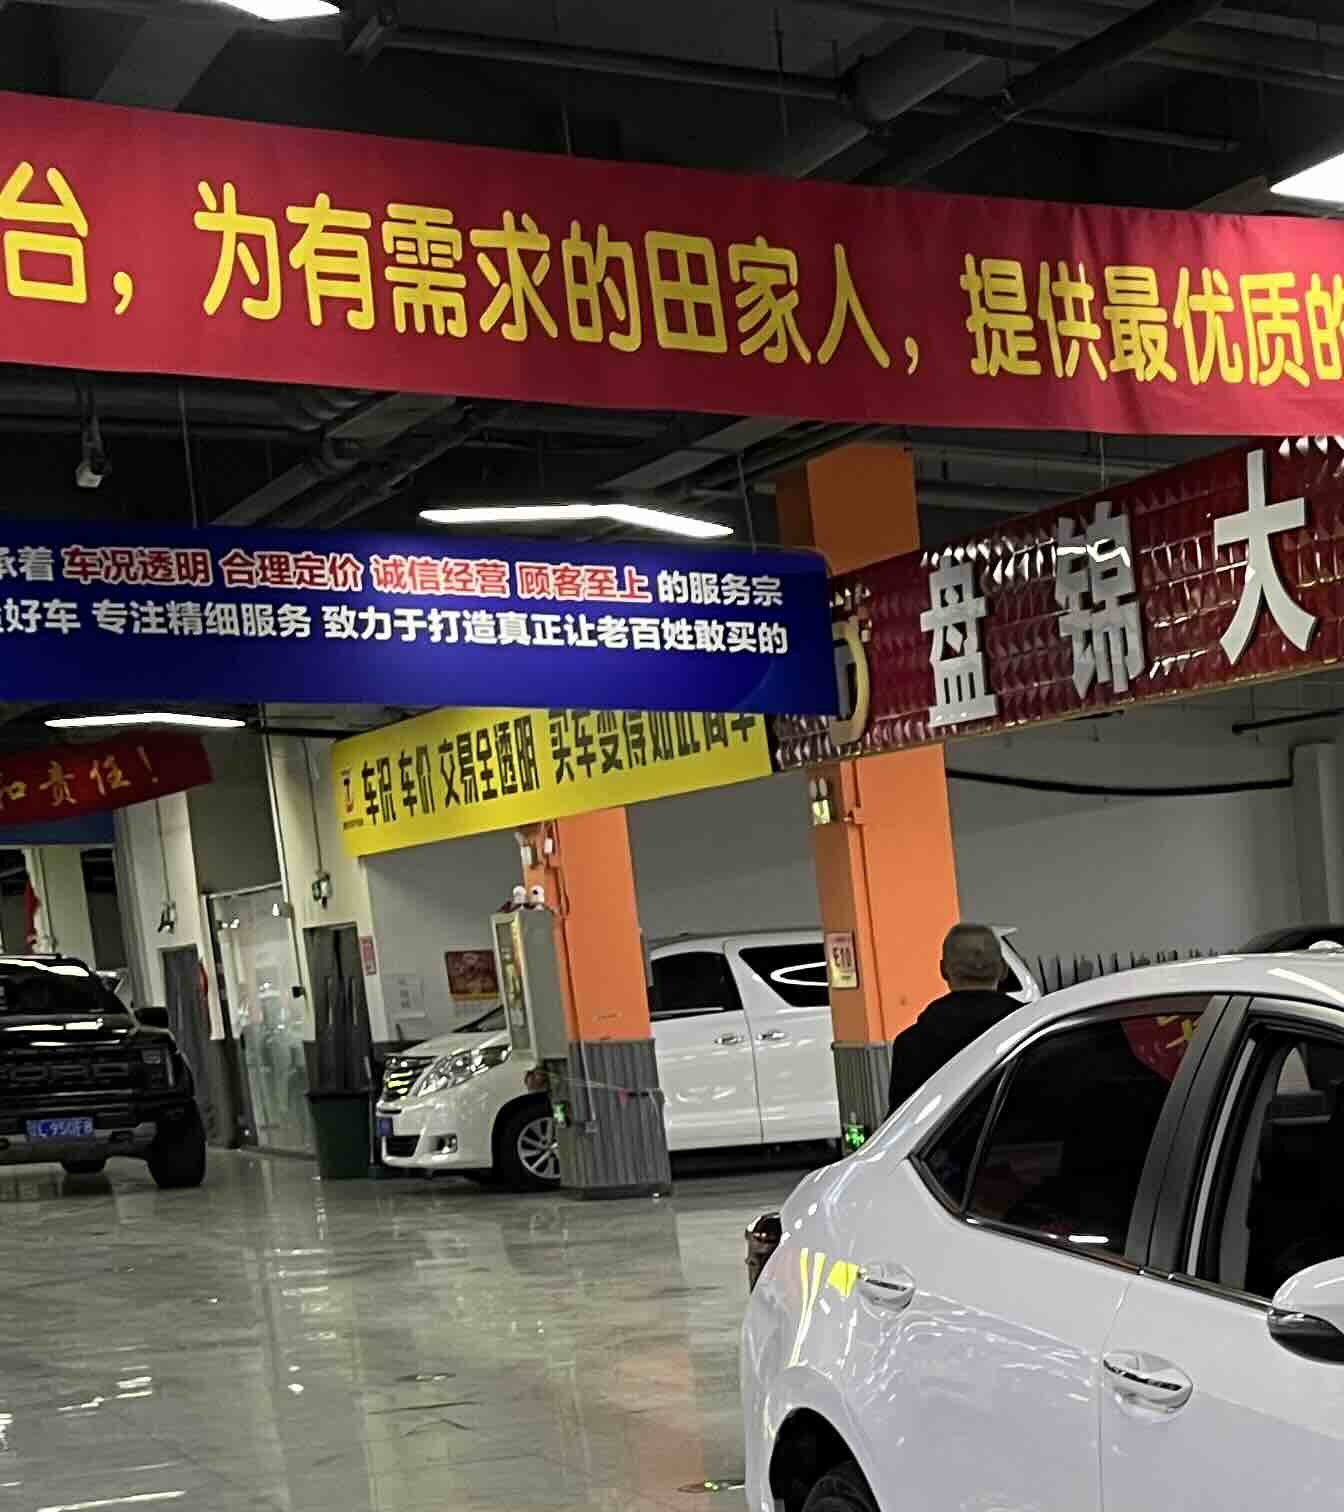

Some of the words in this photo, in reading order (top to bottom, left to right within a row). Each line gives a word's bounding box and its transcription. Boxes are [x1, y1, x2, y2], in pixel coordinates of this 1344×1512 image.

[62, 545, 213, 586] 车况透明
[219, 549, 364, 591] 合理定价
[369, 554, 510, 597] 诚信经营
[515, 561, 652, 602] 顾客至上
[657, 569, 783, 607] 的服务宗
[0, 598, 80, 634] 好车
[92, 597, 311, 639] 专注精细服务
[321, 605, 788, 655] 致力于打造真正让老百姓敢买的
